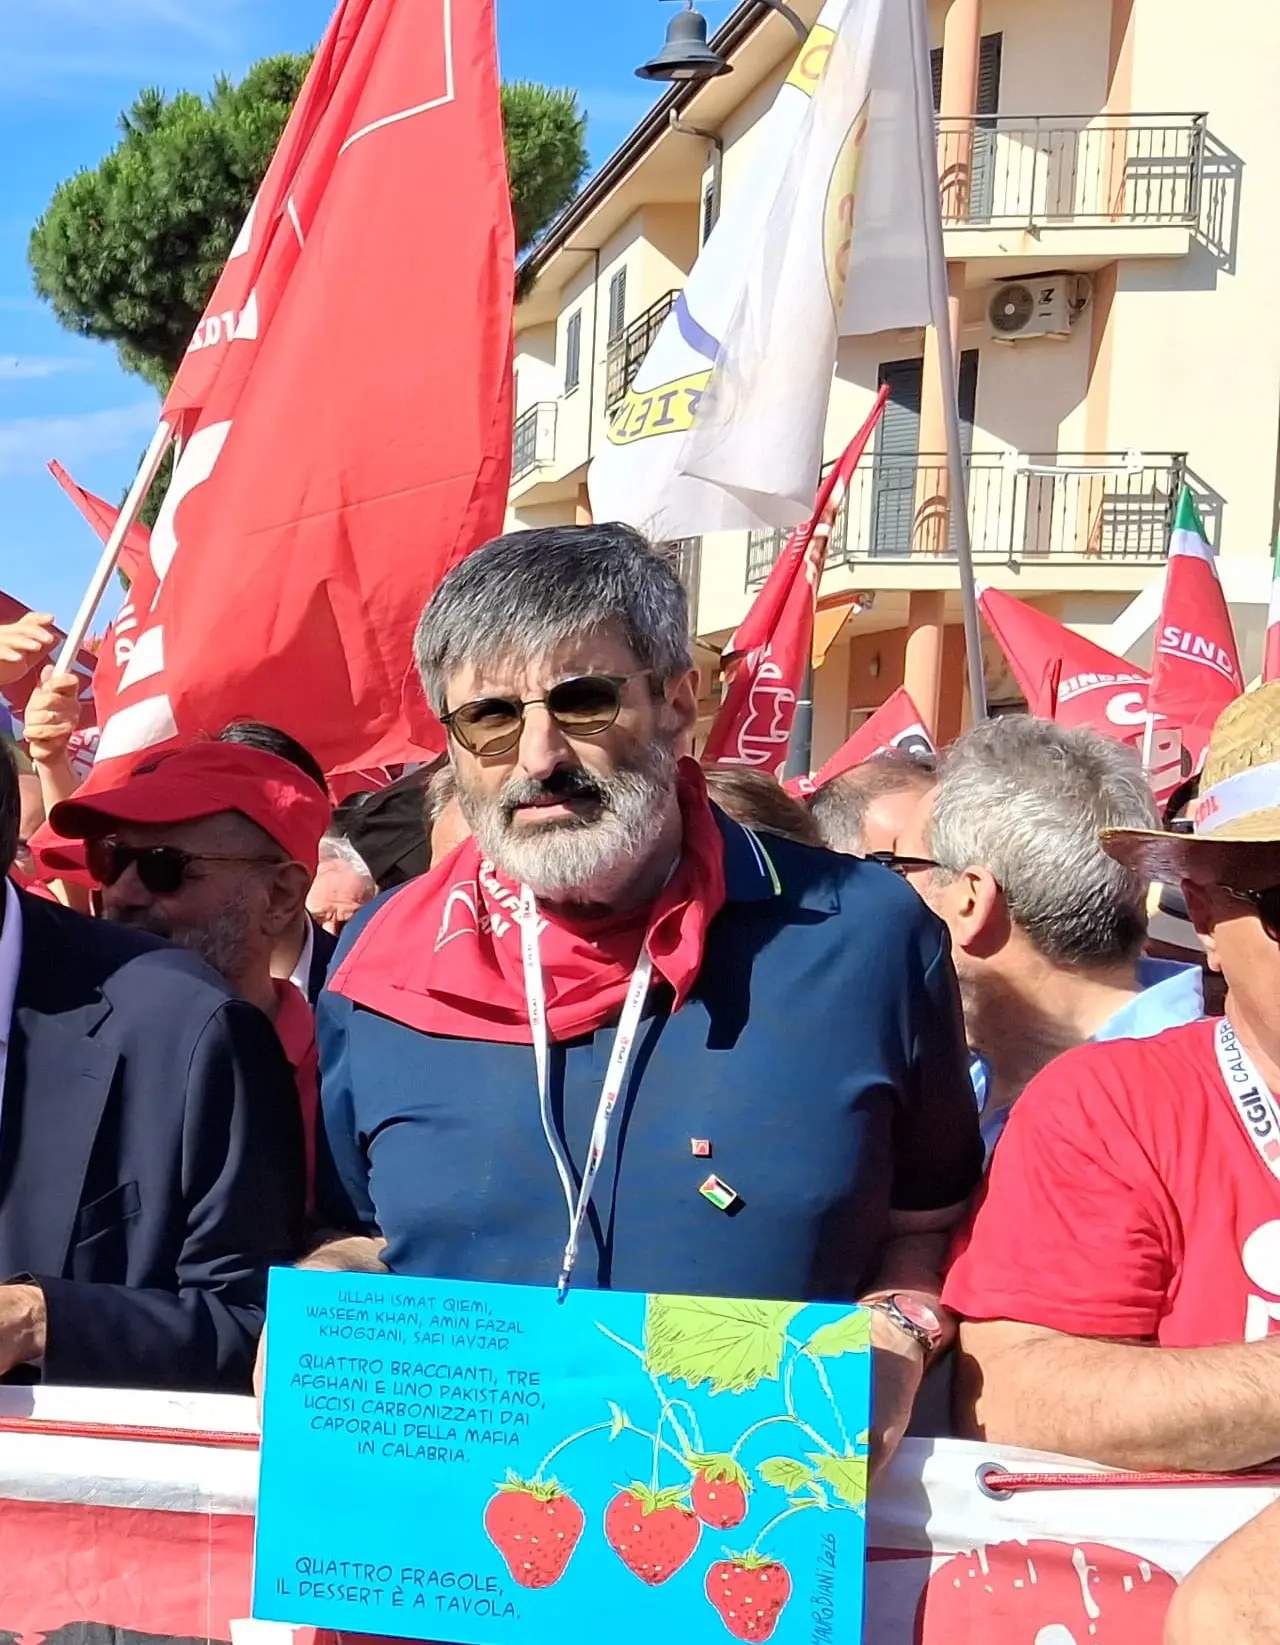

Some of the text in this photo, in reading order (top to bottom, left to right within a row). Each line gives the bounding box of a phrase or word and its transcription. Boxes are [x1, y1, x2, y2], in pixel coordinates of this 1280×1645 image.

[1160, 626, 1237, 678] SIND
[1240, 1086, 1272, 1138] CGIL
[339, 1290, 384, 1304] ULLAH
[391, 1293, 436, 1308] ISMAT
[306, 1306, 524, 1334] WASEEM KHAN, AMIN FAZAL
[414, 1332, 444, 1345] SAFI
[299, 1354, 540, 1385] QUATTRO BRACCIANTI, TRE
[291, 1373, 545, 1409] AFGHANI E UNO PAKISTANO,
[305, 1394, 528, 1425] UCCISI CARBONIZZATI DAI
[311, 1416, 519, 1445] CAPORALI DELLA MAFIA
[358, 1440, 469, 1463] IN CALABRIA.
[295, 1556, 503, 1596] QUATTRO FRAGOLE,
[276, 1578, 521, 1619] IL DESSERT È A TAVOLA.
